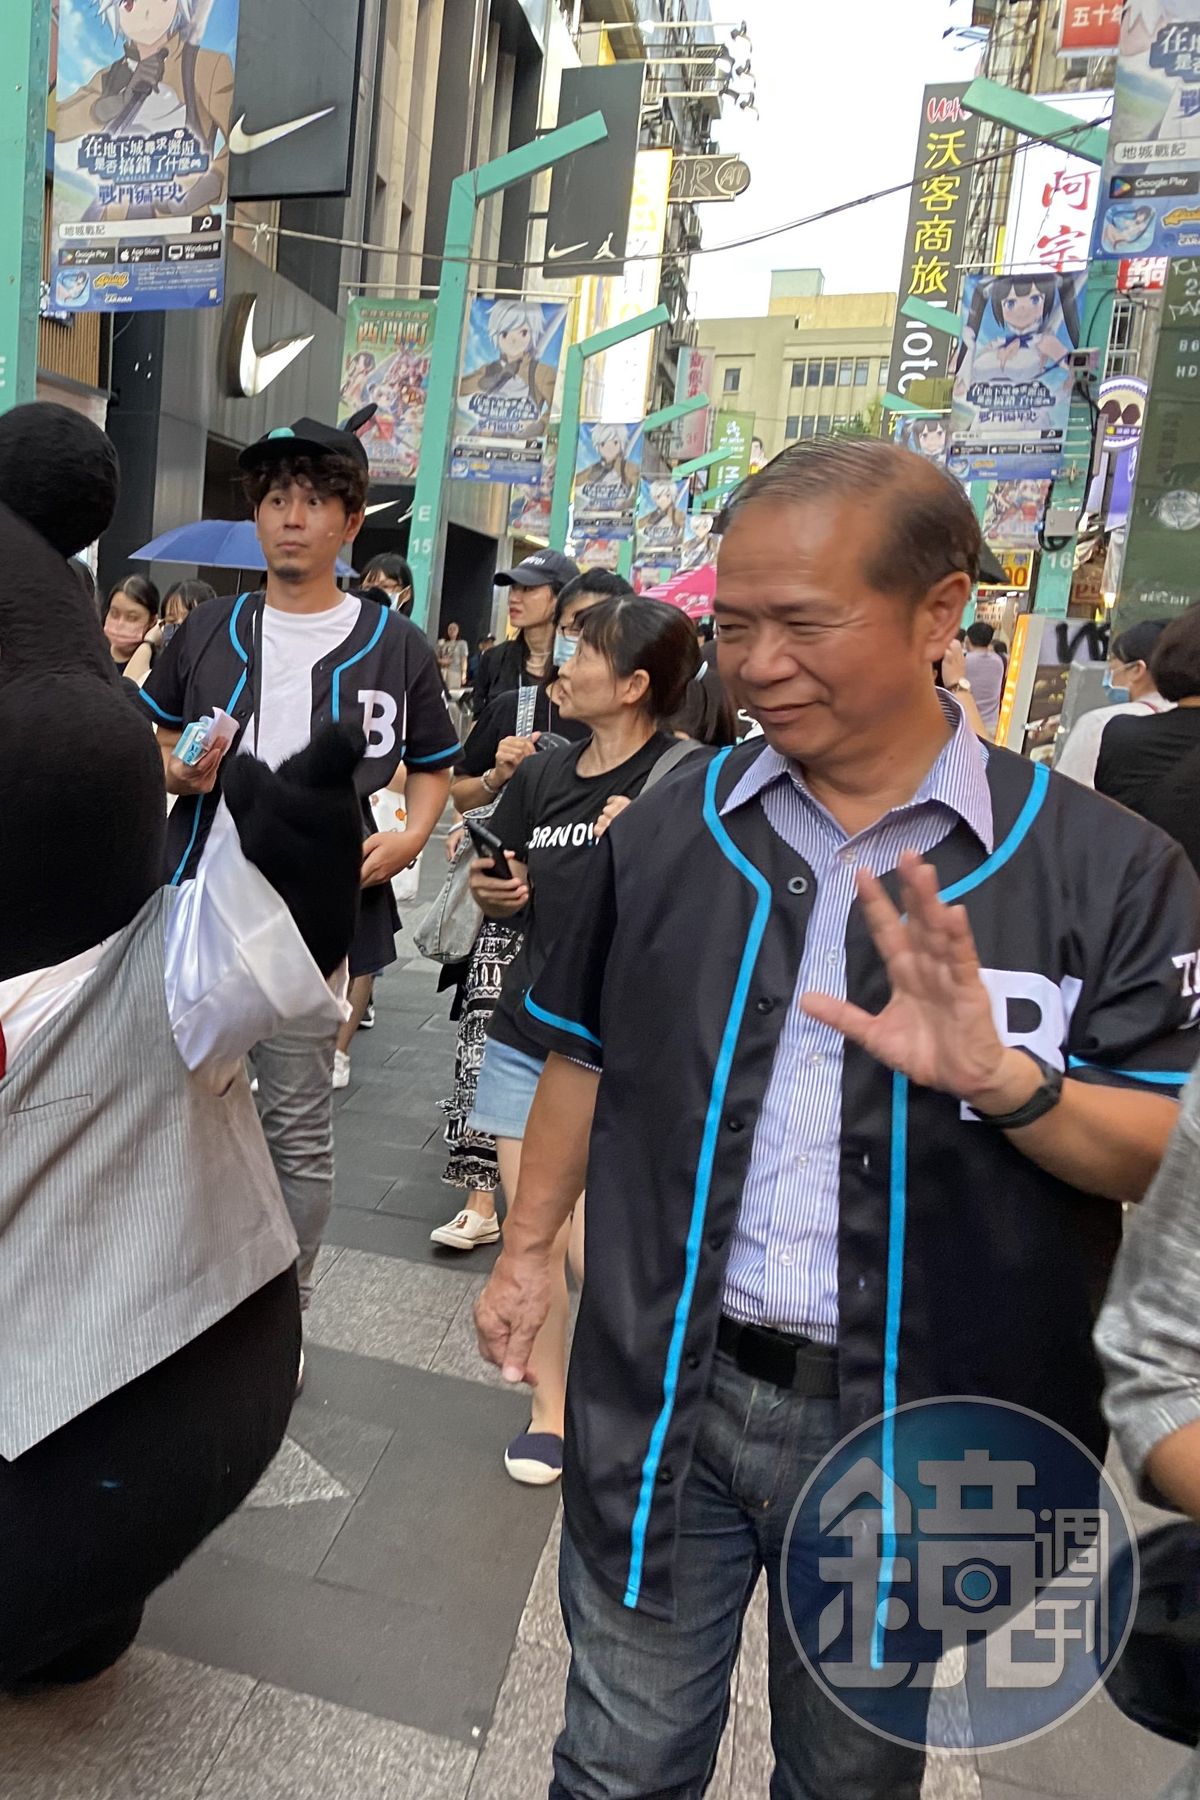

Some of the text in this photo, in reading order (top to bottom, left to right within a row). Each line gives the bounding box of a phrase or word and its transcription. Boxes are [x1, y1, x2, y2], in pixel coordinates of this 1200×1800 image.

[1122, 142, 1186, 159] 地城戰記
[1135, 176, 1188, 188] Google Play
[907, 129, 967, 294] 沃客商旅
[1036, 170, 1100, 273] 阿宗
[417, 504, 432, 522] E
[411, 538, 433, 554] 15
[1047, 553, 1072, 570] 16
[357, 689, 398, 759] B
